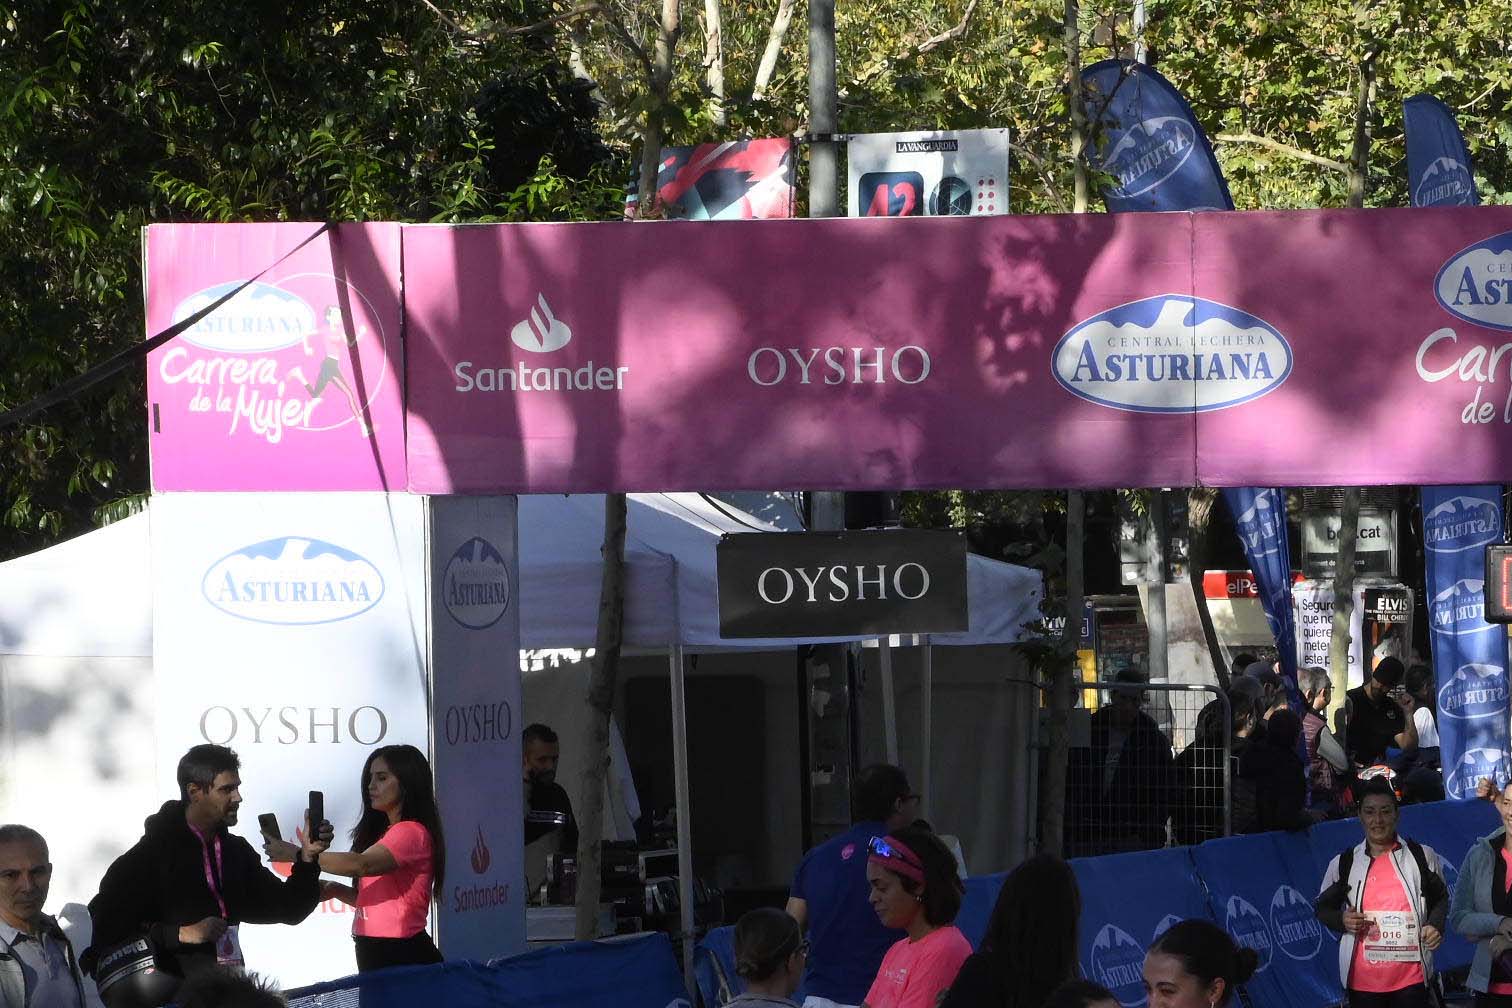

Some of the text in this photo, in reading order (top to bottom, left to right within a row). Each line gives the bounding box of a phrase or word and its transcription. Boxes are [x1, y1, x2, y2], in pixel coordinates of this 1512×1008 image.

[1107, 335, 1266, 348] CENTRAL LECHERA
[160, 347, 278, 385] Carrera
[455, 361, 628, 392] Santander
[747, 345, 931, 387] OYSHO
[1071, 339, 1274, 382] ASTURIANA
[189, 381, 322, 444] de la Mujer
[1461, 386, 1496, 425] de
[218, 569, 371, 602] ASTURIANA
[449, 575, 505, 607] ASTURIANA
[758, 562, 930, 605] OYSHO
[1377, 598, 1408, 611] ELVIS
[1303, 615, 1319, 629] que
[1304, 628, 1332, 640] quiere
[1305, 652, 1323, 665] este
[199, 706, 388, 745] OYSHO
[445, 700, 512, 745] OYSHO
[455, 880, 509, 912] Santander
[1382, 931, 1402, 939] 016
